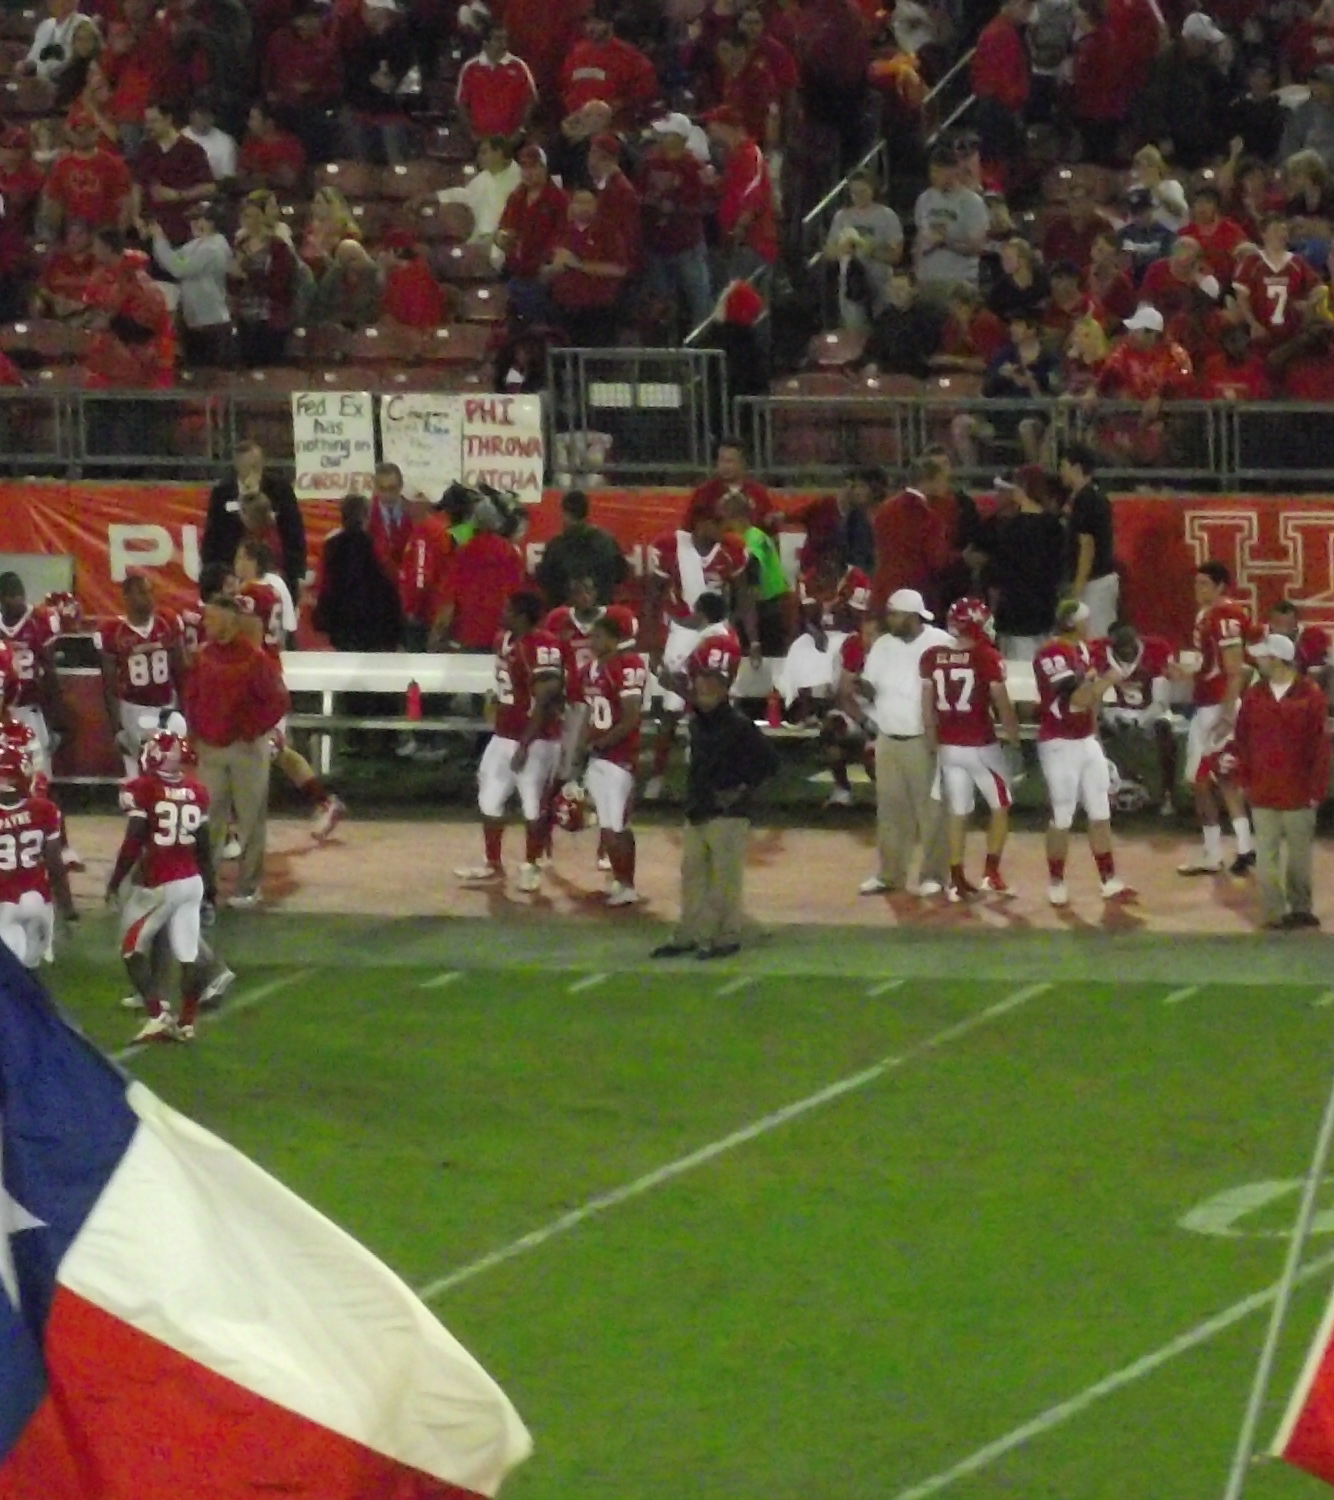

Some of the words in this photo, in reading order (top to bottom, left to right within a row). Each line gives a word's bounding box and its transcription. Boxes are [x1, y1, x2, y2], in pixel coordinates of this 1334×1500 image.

[1266, 285, 1288, 325] 7
[338, 395, 364, 417] Ex
[465, 398, 516, 426] PHI
[313, 418, 344, 436] has
[296, 437, 351, 459] nothing
[353, 440, 372, 452] on
[127, 651, 169, 687] 88
[932, 669, 976, 712] 17
